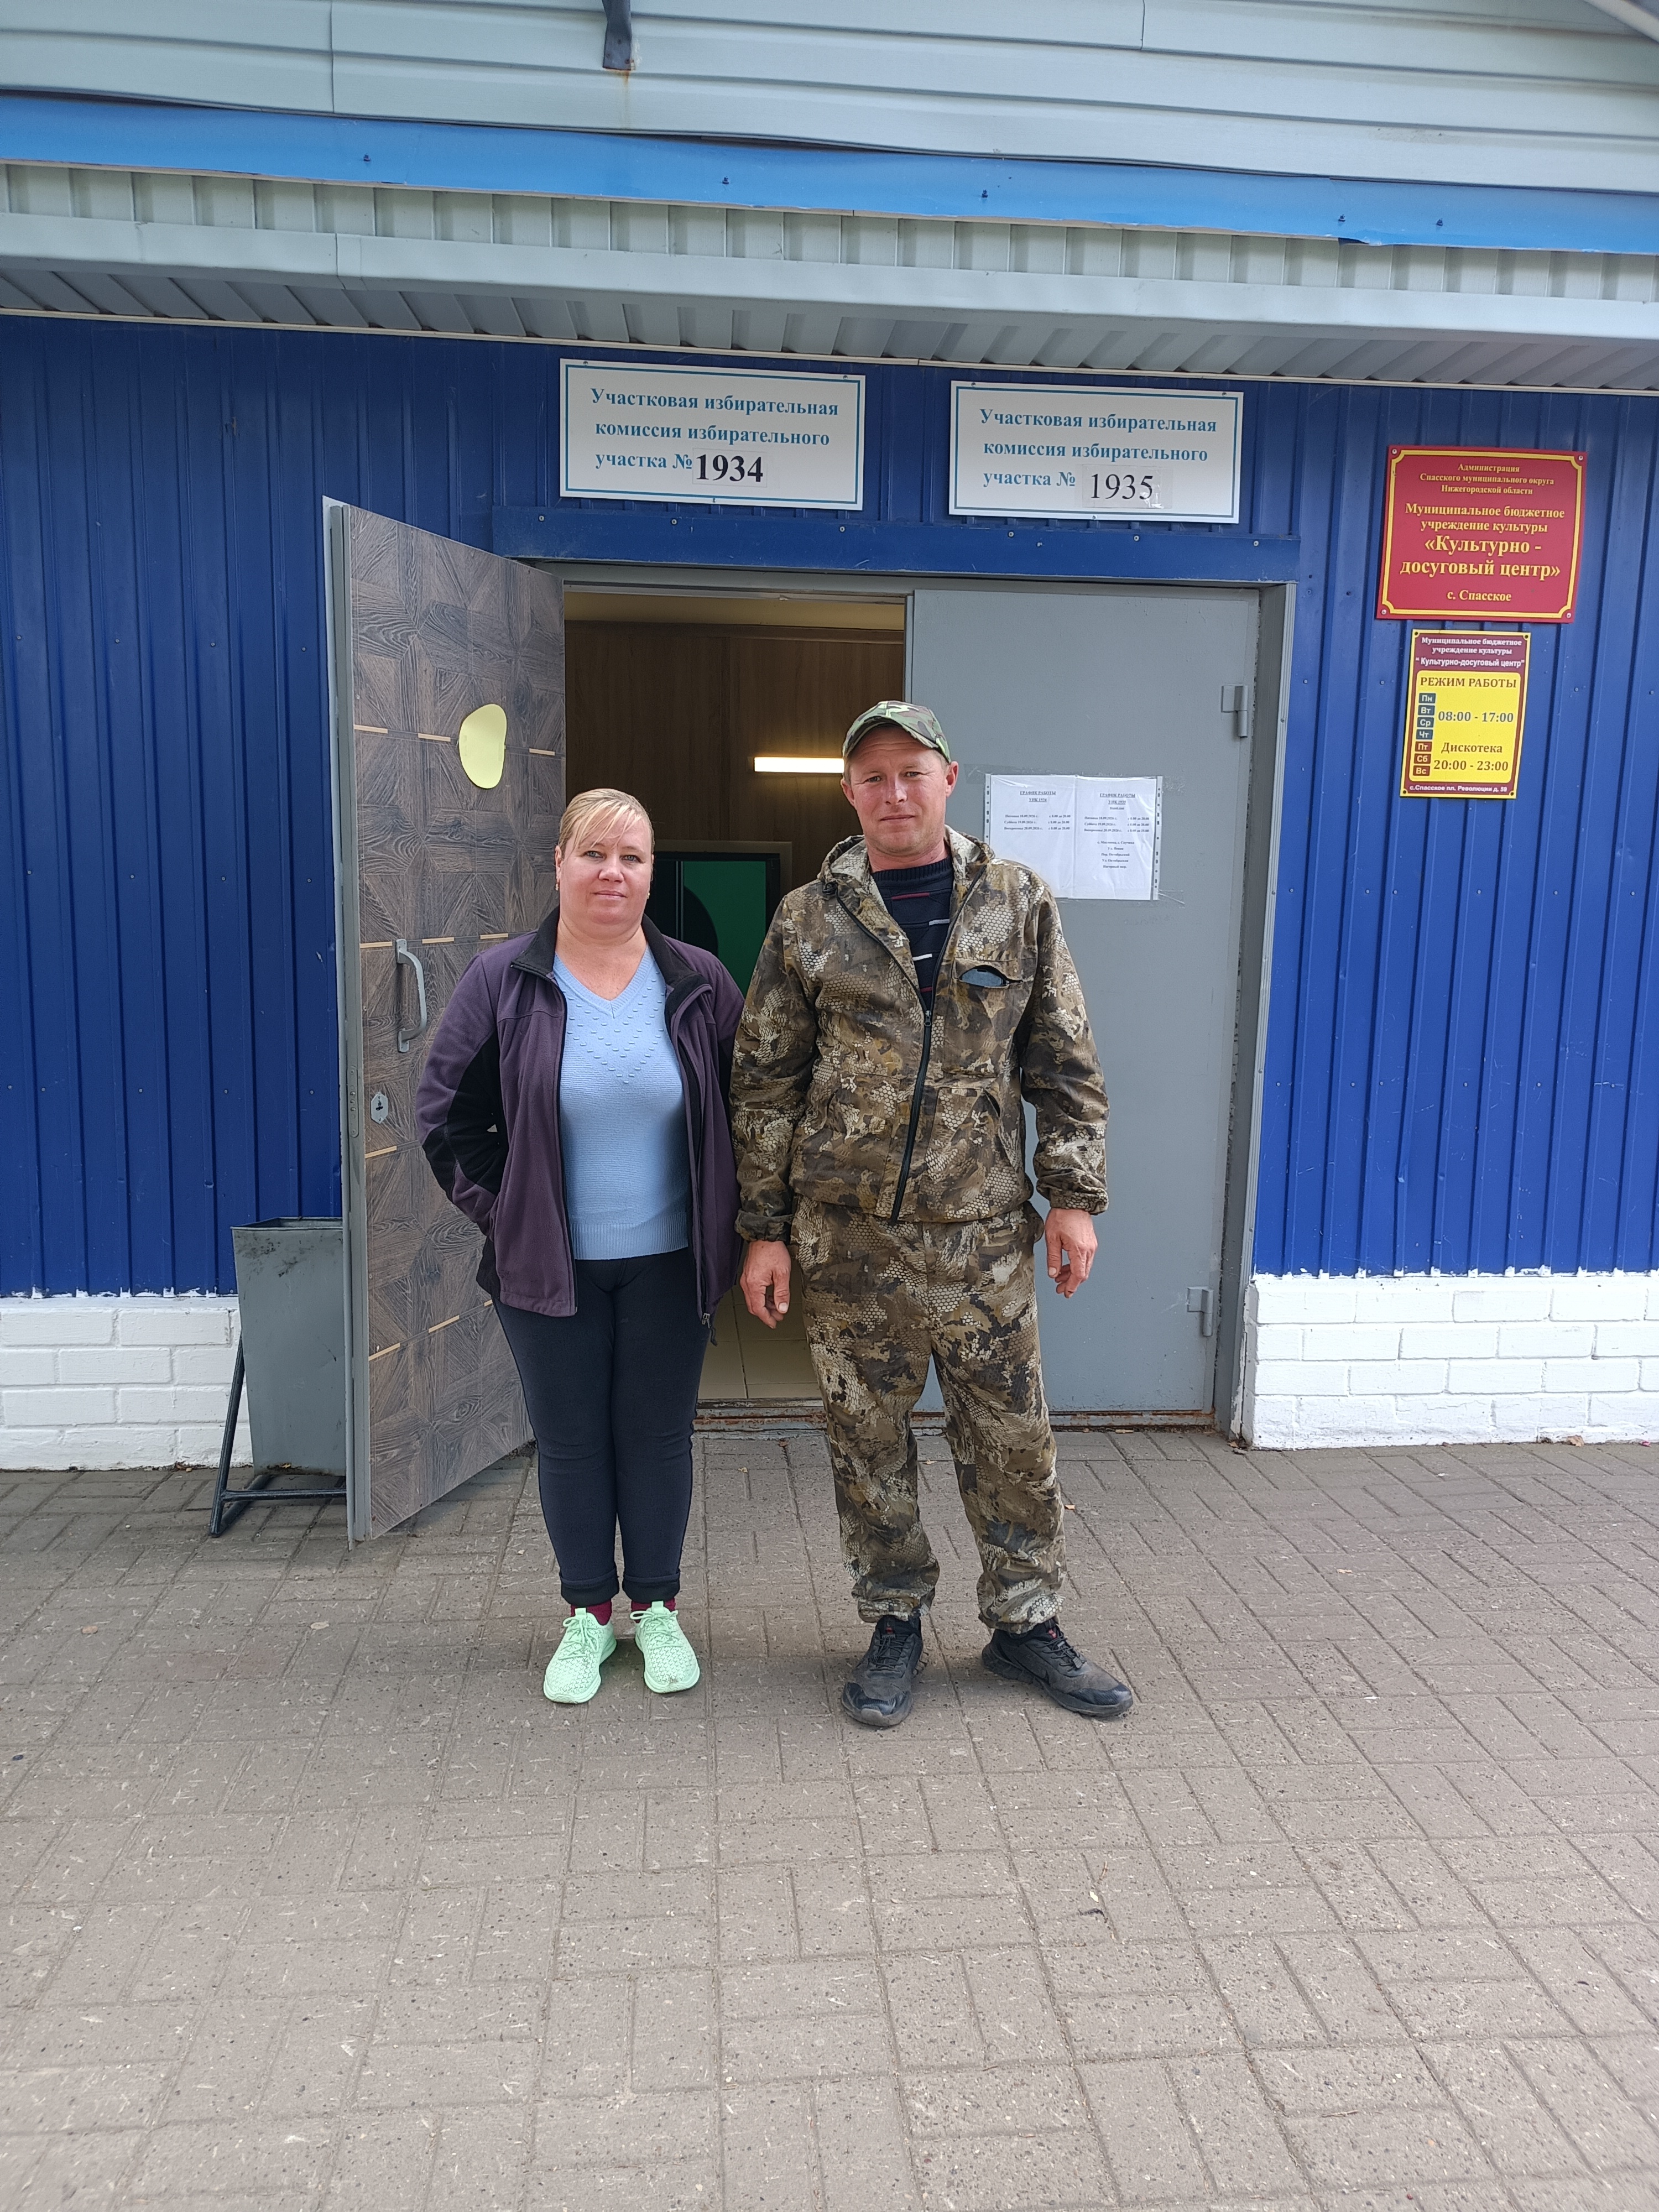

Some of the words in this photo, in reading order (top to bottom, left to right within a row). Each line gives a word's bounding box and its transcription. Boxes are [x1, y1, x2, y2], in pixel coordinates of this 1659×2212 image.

[590, 387, 698, 409] Участковая
[704, 395, 838, 416] избирательная
[979, 408, 1082, 427] Участковая
[1088, 414, 1217, 433] избирательная
[595, 422, 682, 439] комиссия
[687, 425, 830, 446] избирательного
[983, 442, 1066, 457] комиссия
[1071, 443, 1208, 463] избирательного
[595, 452, 667, 469] участка
[672, 453, 692, 470] №
[696, 454, 764, 482] 1934
[1457, 463, 1520, 473] Администрация
[1420, 473, 1460, 483] Спасского
[1462, 476, 1527, 485] муниципального
[983, 472, 1052, 488] участка
[1056, 472, 1076, 487] №
[1091, 473, 1154, 500] 1935
[1441, 484, 1501, 494] Нижегородской
[1503, 487, 1533, 495] области
[1405, 503, 1501, 517] Муниципальное
[1504, 505, 1565, 519] бюджетное
[1420, 520, 1490, 531] учреждение
[1492, 523, 1548, 535] культуры
[1400, 560, 1494, 578] досуговый
[1499, 563, 1561, 581] центр»
[1447, 591, 1456, 600] с.
[1459, 589, 1512, 602] Спасское
[1421, 637, 1481, 645] Муниципальное
[1421, 658, 1499, 667] Культурно-досуговый
[1420, 677, 1465, 687] РЕЖИМ
[1468, 678, 1517, 688] РАБОТЫ
[1438, 711, 1472, 722] 08:00
[1481, 712, 1514, 723] 17:00
[1420, 719, 1431, 728] Ср
[1441, 742, 1503, 754] Дискотека
[1433, 759, 1467, 770] 20:00
[1477, 760, 1509, 771] 23:00
